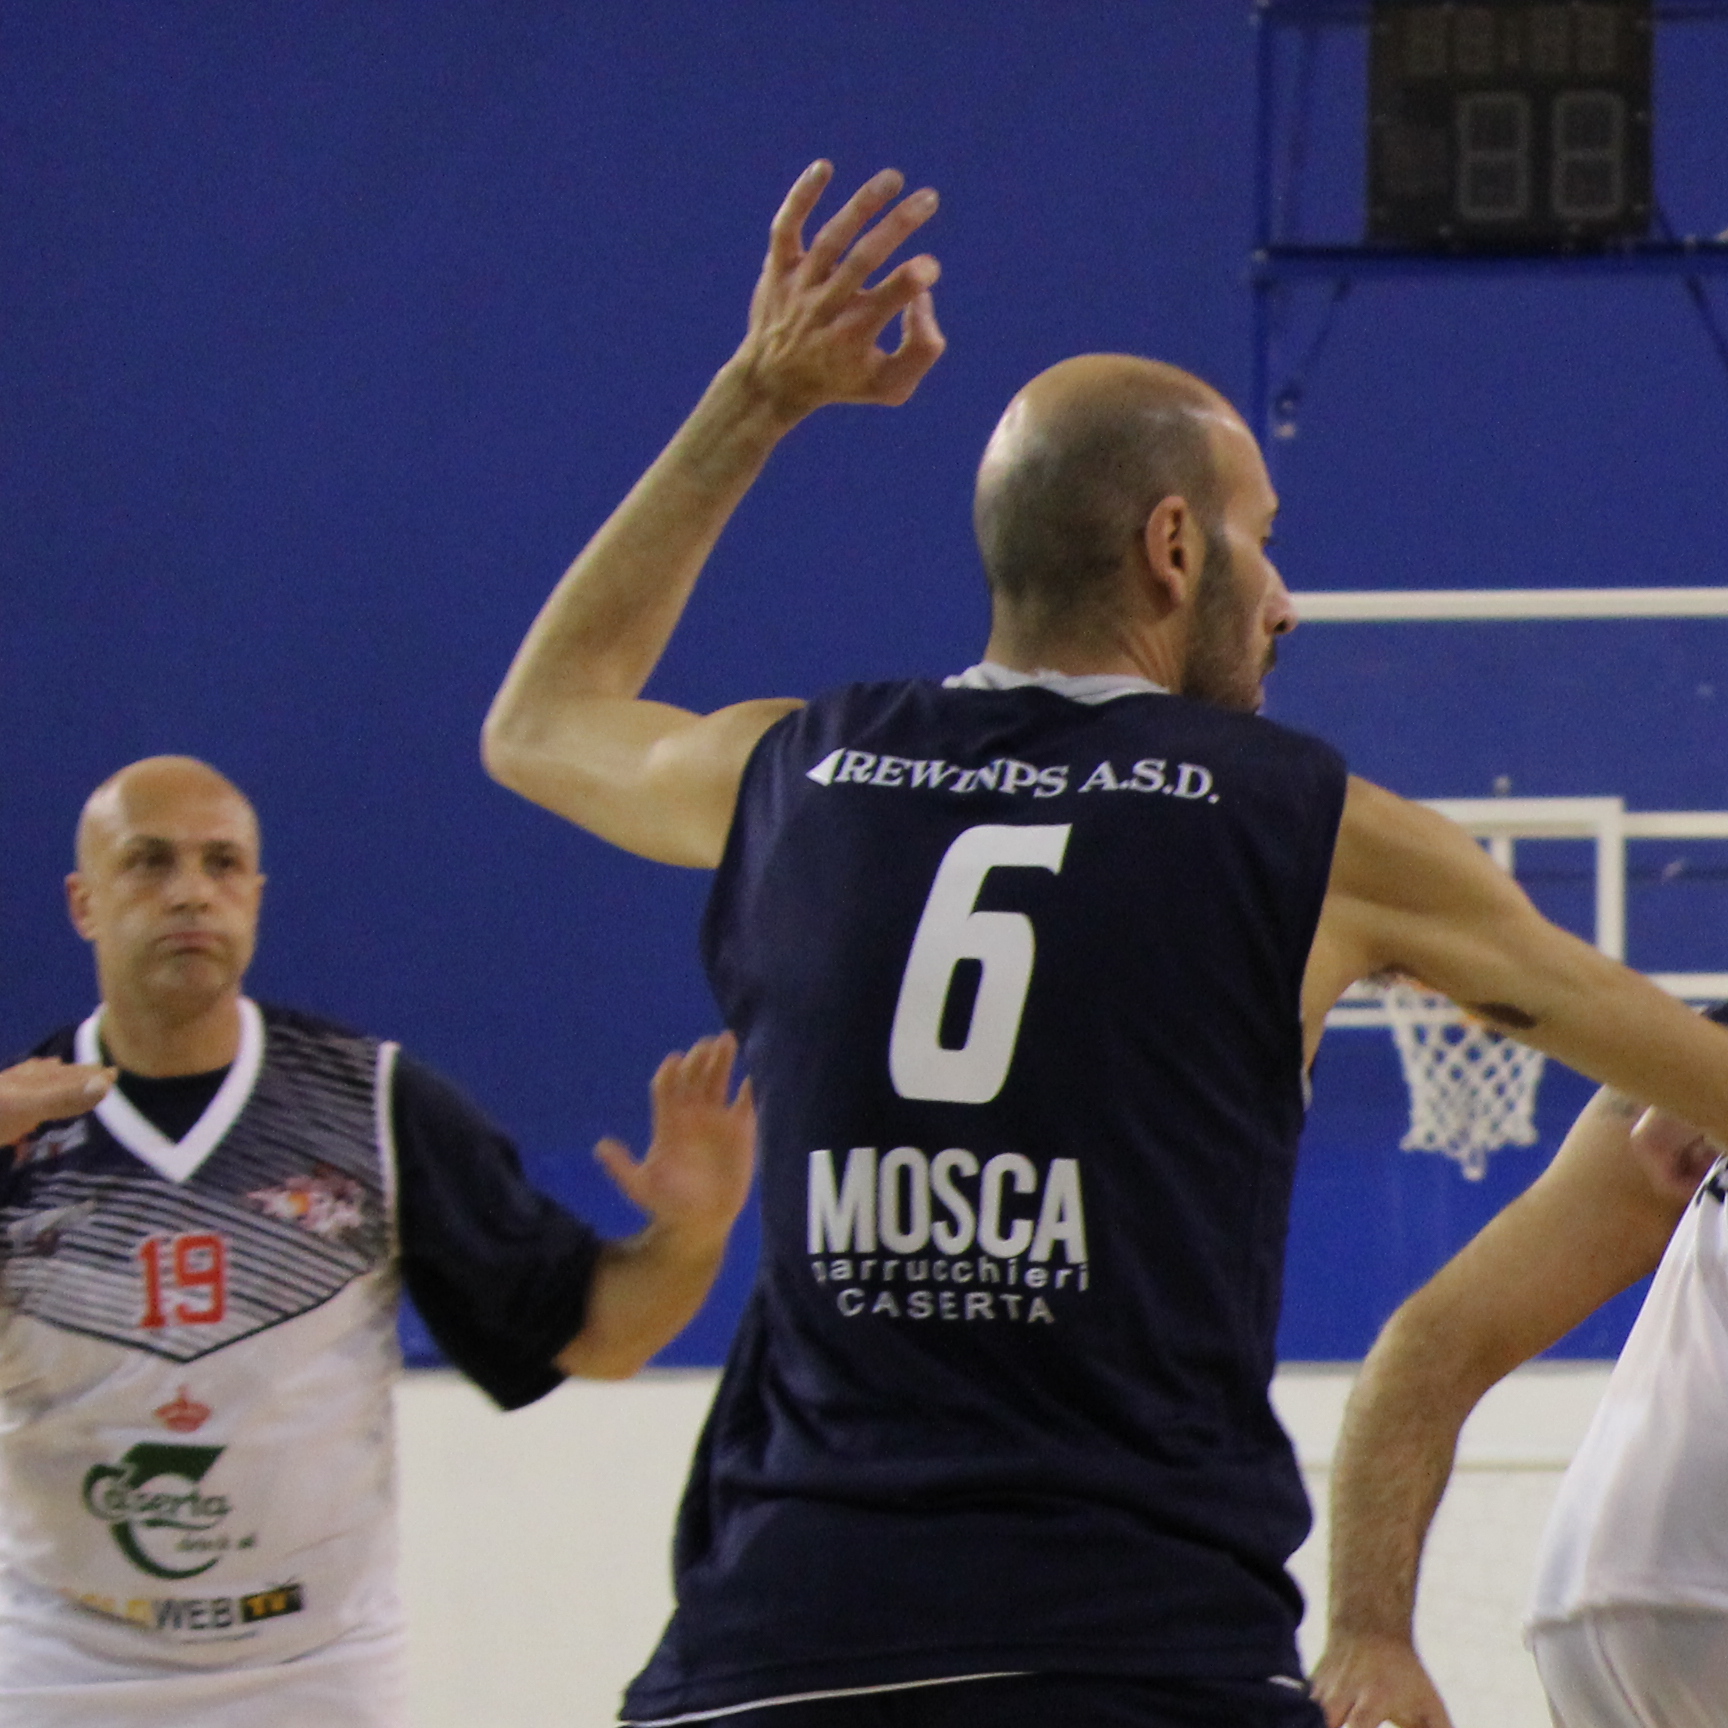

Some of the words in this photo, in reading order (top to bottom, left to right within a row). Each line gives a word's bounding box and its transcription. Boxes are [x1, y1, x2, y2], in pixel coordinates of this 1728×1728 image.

[1078, 759, 1219, 804] A.S.D.
[889, 823, 1072, 1105] 6
[807, 1147, 1089, 1263] MOSCA
[135, 1235, 226, 1329] 19
[837, 1288, 1055, 1324] CASERTA
